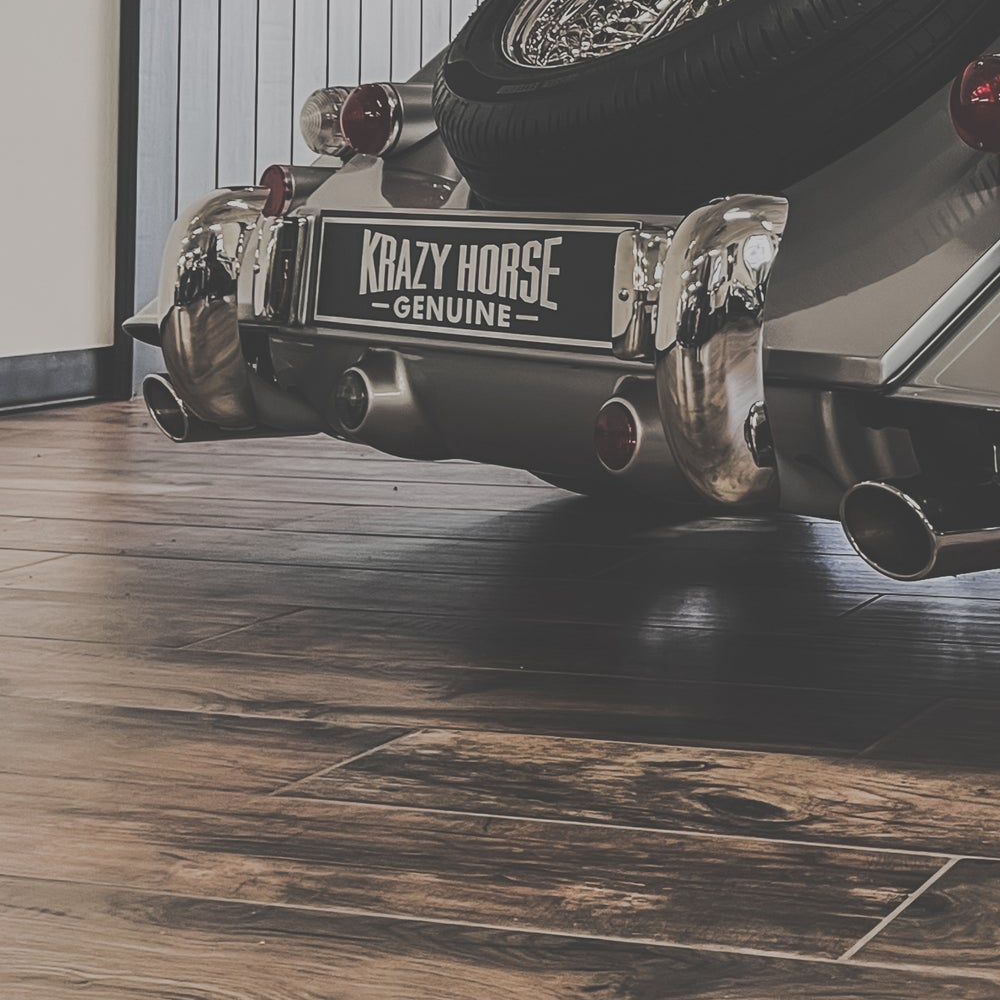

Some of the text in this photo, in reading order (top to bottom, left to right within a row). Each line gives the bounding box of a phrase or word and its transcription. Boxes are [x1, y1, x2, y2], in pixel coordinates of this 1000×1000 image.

[359, 228, 563, 311] KRAZY HORSE
[393, 295, 512, 328] GENUINE
